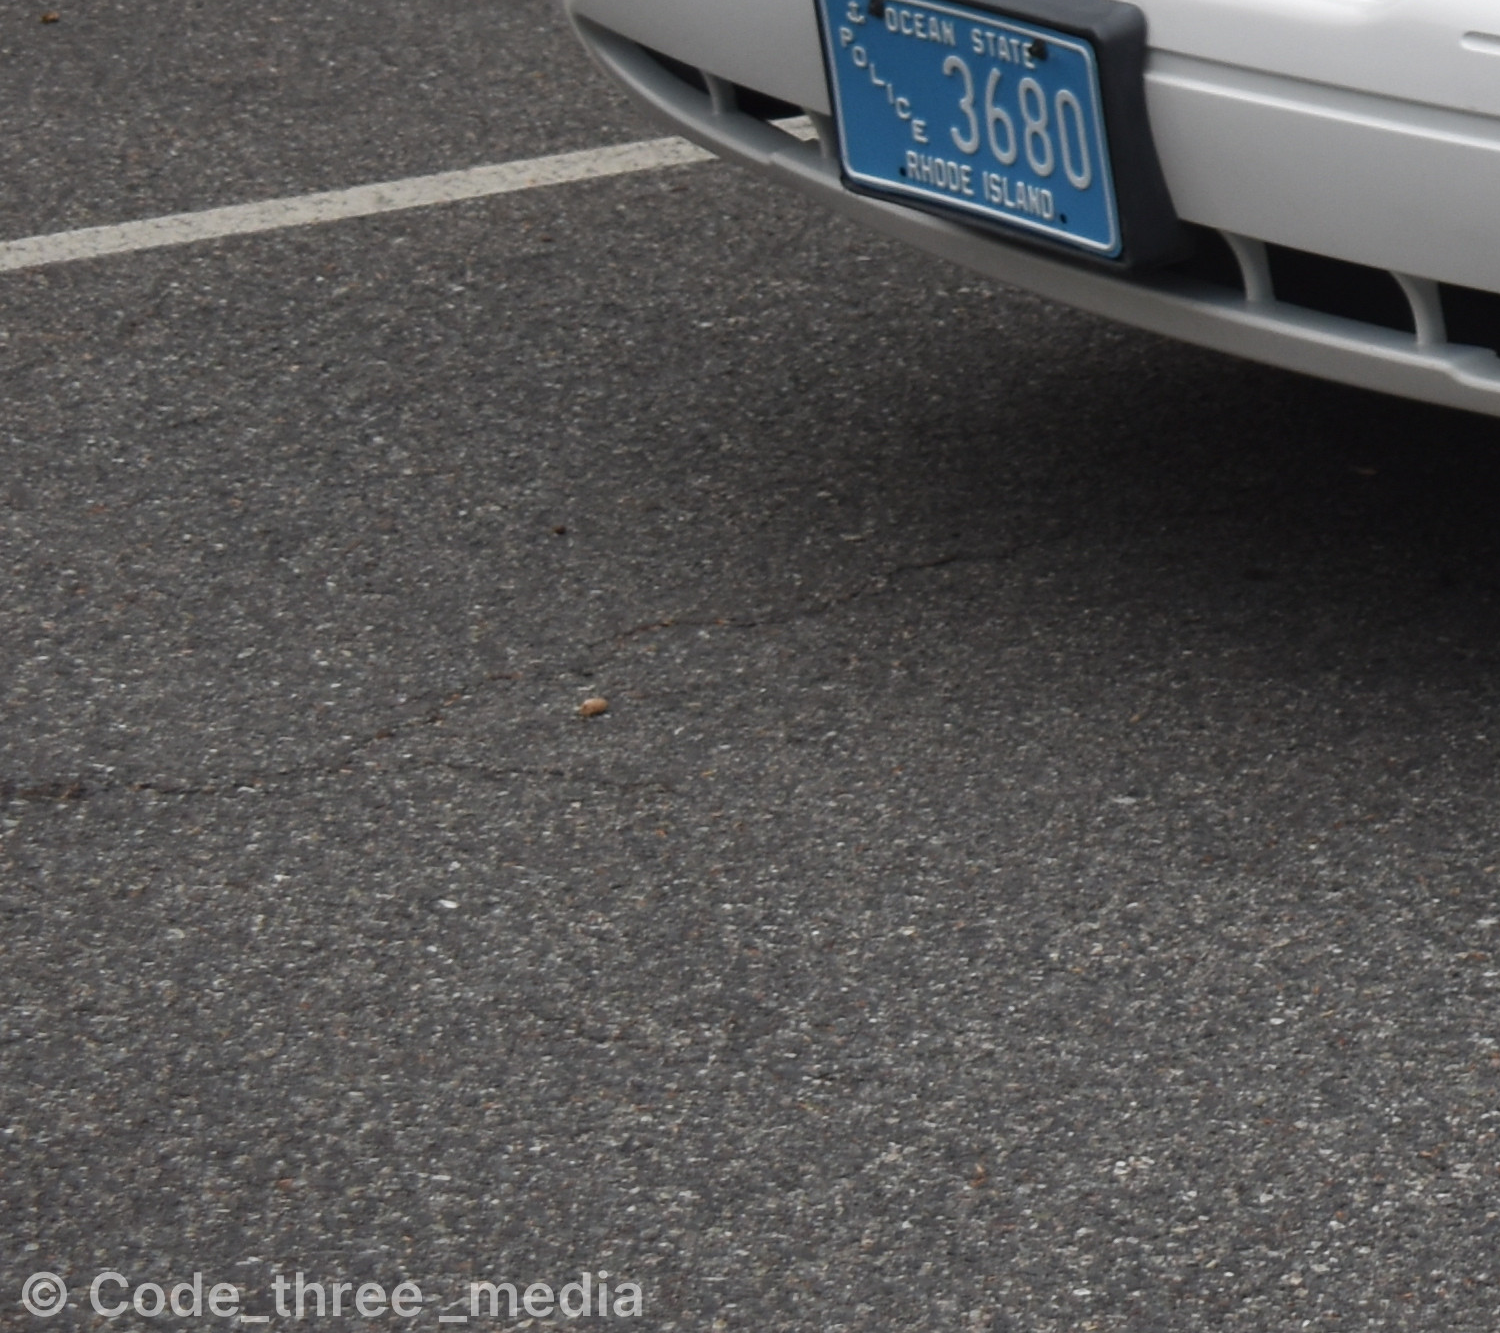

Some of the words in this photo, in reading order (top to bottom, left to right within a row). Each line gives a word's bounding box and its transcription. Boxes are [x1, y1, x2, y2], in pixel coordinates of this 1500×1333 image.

[839, 26, 928, 144] POLICE
[884, 6, 957, 47] OCEAN
[971, 28, 1036, 70] STATE
[943, 54, 1092, 190] 3680
[905, 150, 975, 196] RHODE
[982, 170, 1055, 221] ISLAND
